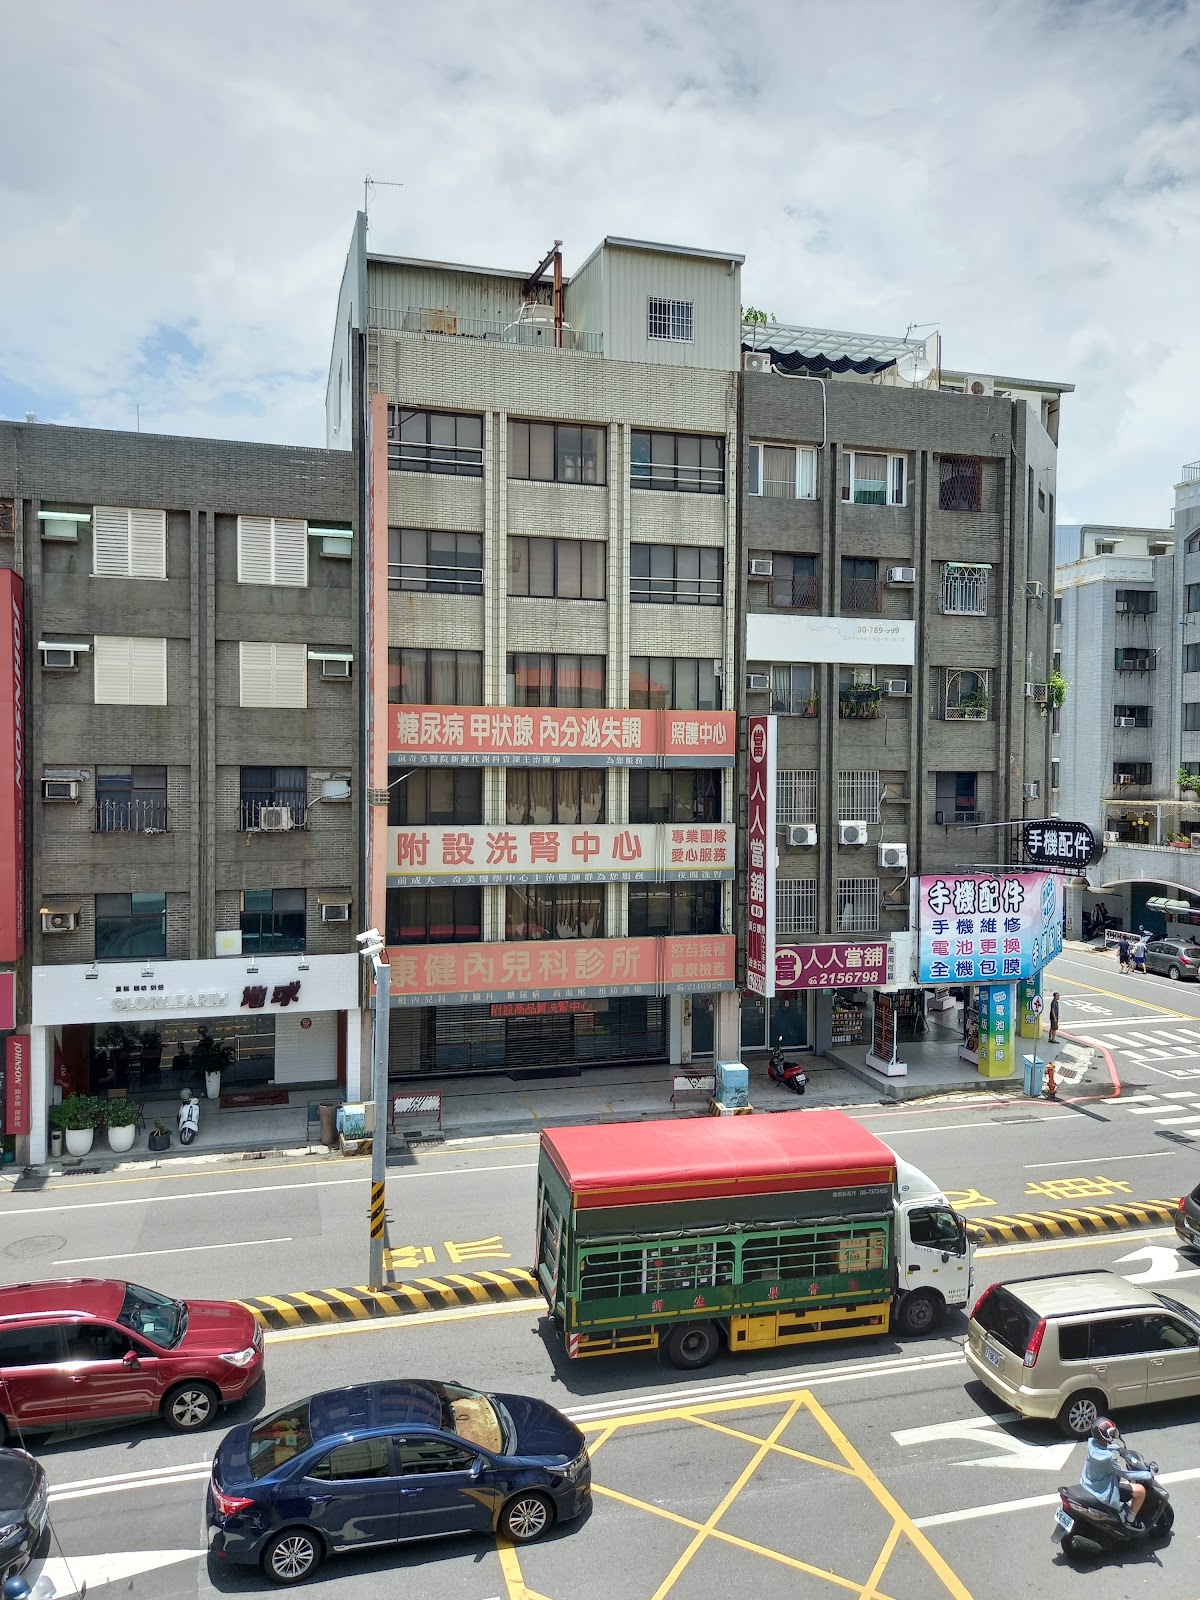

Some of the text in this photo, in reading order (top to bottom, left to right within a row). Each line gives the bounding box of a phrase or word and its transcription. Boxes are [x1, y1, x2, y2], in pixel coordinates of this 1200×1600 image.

[14, 595, 23, 791] JOHNSON
[397, 711, 642, 748] 糖尿病 甲狀腺 內分泌失調
[671, 721, 727, 746] 照護中心
[671, 829, 727, 844] 專業團隊
[1027, 829, 1090, 860] 手機配件
[397, 831, 643, 866] 附設洗腎中心
[671, 848, 727, 863] 愛心服務
[677, 870, 723, 880] 夜間洗腎
[927, 878, 1025, 916] 手機配件
[931, 916, 1022, 935] 手機維修
[671, 941, 727, 958] 疫苗接種
[804, 947, 884, 970] 人人當舖
[931, 938, 1022, 957] 電池更換
[389, 946, 641, 987] 康健內兒科診所
[671, 961, 726, 978] 健康檢查
[776, 954, 797, 981] 當
[819, 971, 879, 985] 2156798
[931, 958, 1022, 978] 全機包膜
[112, 991, 228, 1012] GLORY EARTH
[240, 980, 302, 1009] 地球
[507, 989, 541, 1000] 糖尿病
[995, 1004, 1005, 1061] 電池更換
[14, 1041, 22, 1087] JOHNSON
